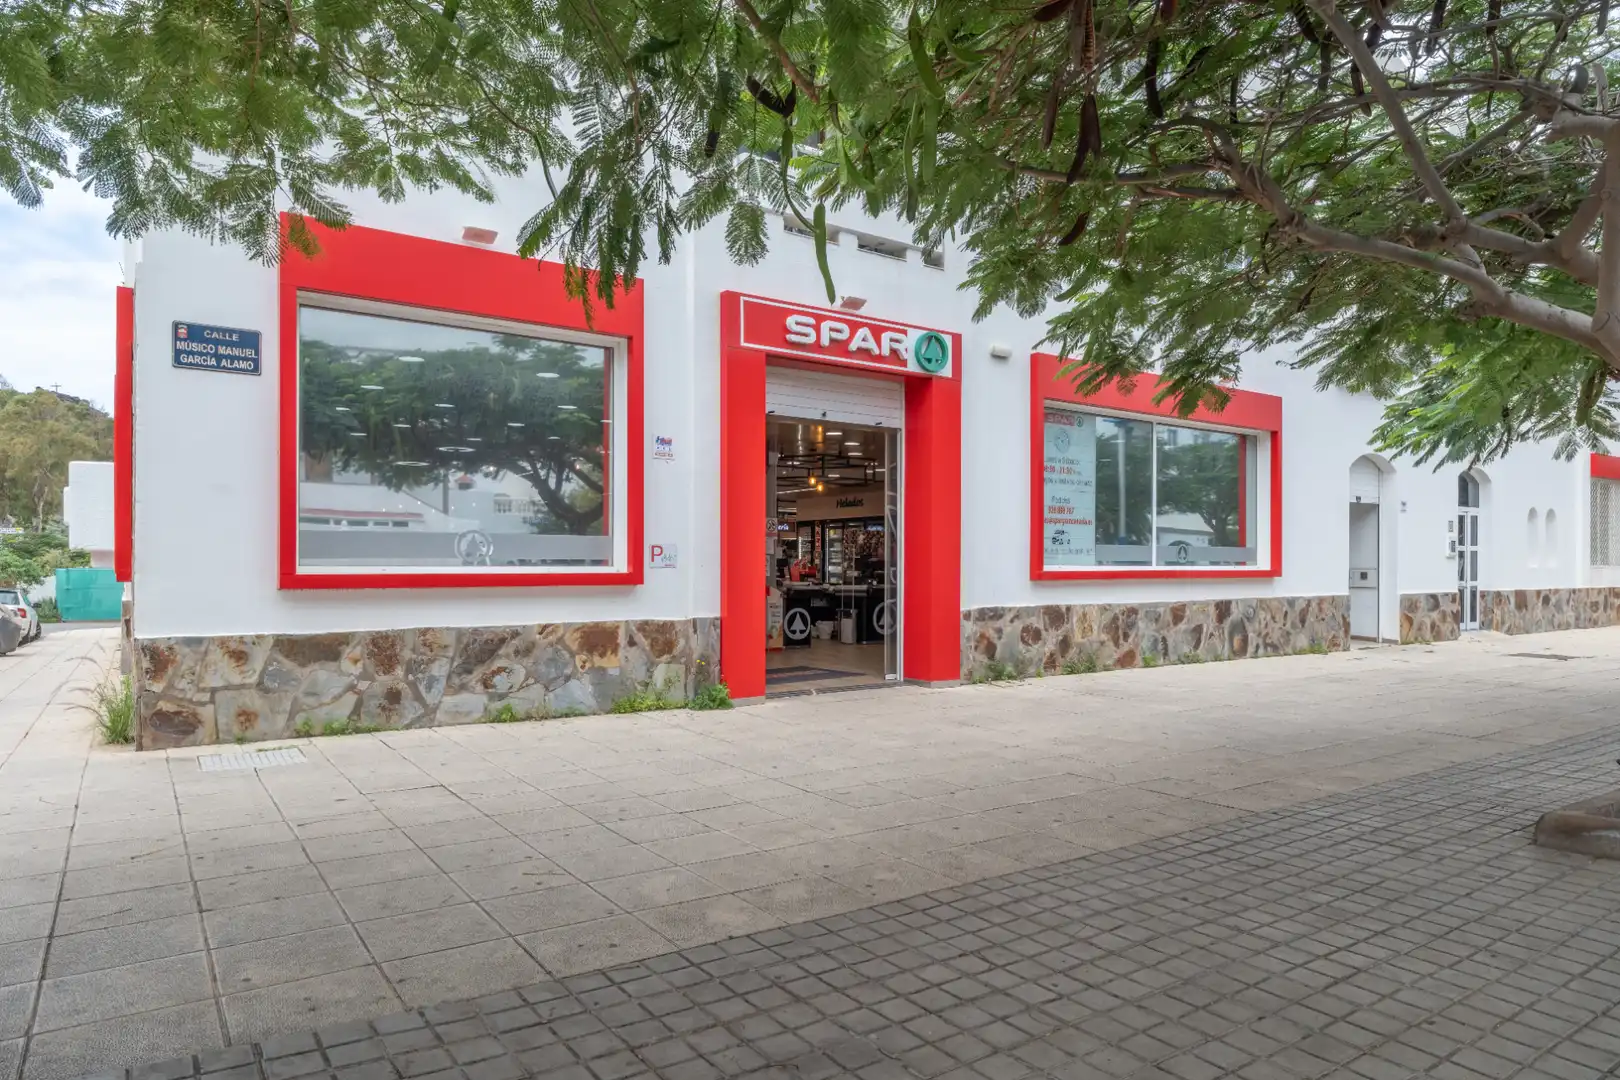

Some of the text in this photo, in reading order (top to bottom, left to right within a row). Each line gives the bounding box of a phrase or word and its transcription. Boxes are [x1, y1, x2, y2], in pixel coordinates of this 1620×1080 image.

[203, 329, 240, 342] CALLE
[785, 314, 908, 361] SPAR
[176, 340, 258, 358] MÚSICO MANUEL
[180, 354, 254, 370] GARCÍA ALAMO
[1047, 413, 1075, 426] SPAR
[836, 497, 864, 509] Helados
